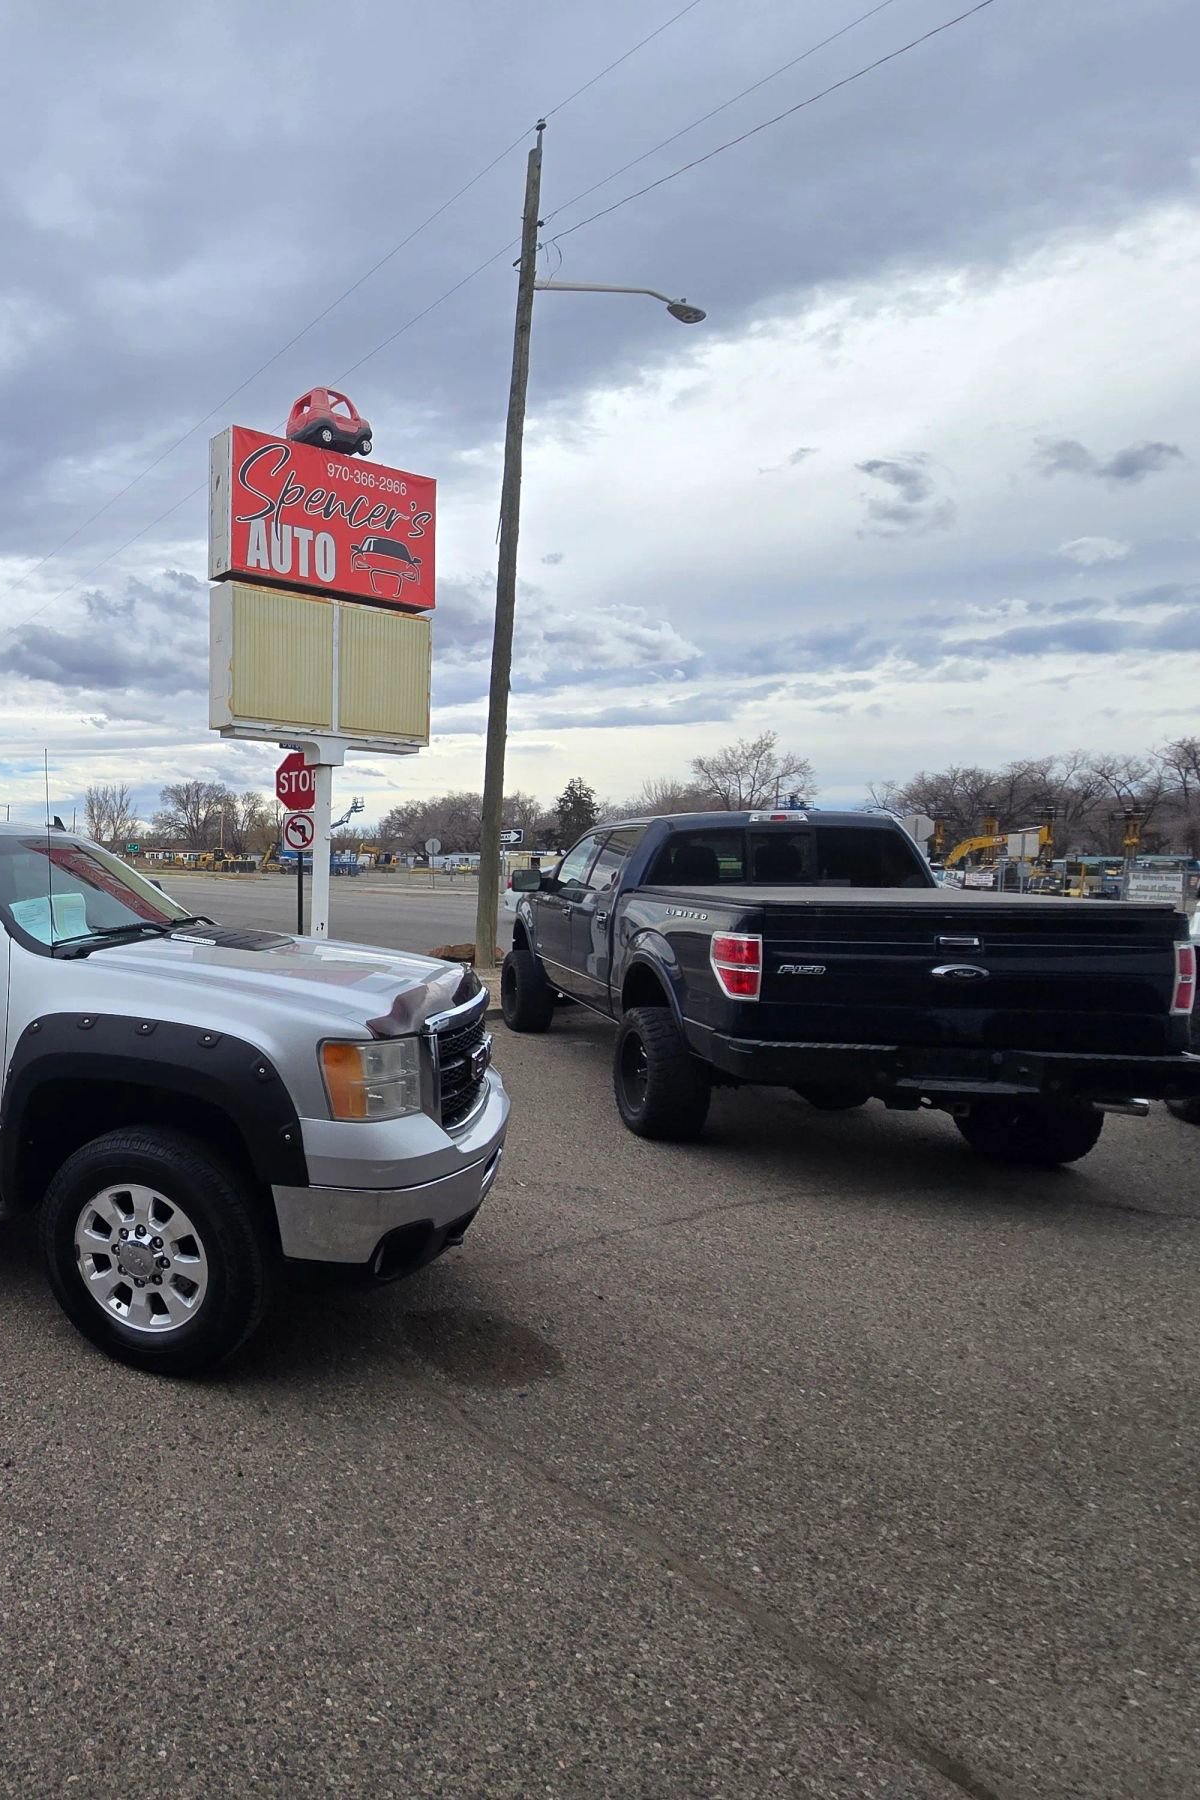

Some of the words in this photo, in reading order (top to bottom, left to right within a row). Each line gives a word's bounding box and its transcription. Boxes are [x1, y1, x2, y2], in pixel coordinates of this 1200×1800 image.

[236, 443, 432, 541] Spencer's
[327, 463, 407, 496] 970-366-2966
[246, 519, 337, 583] AUTO
[665, 908, 708, 921] LIMITED
